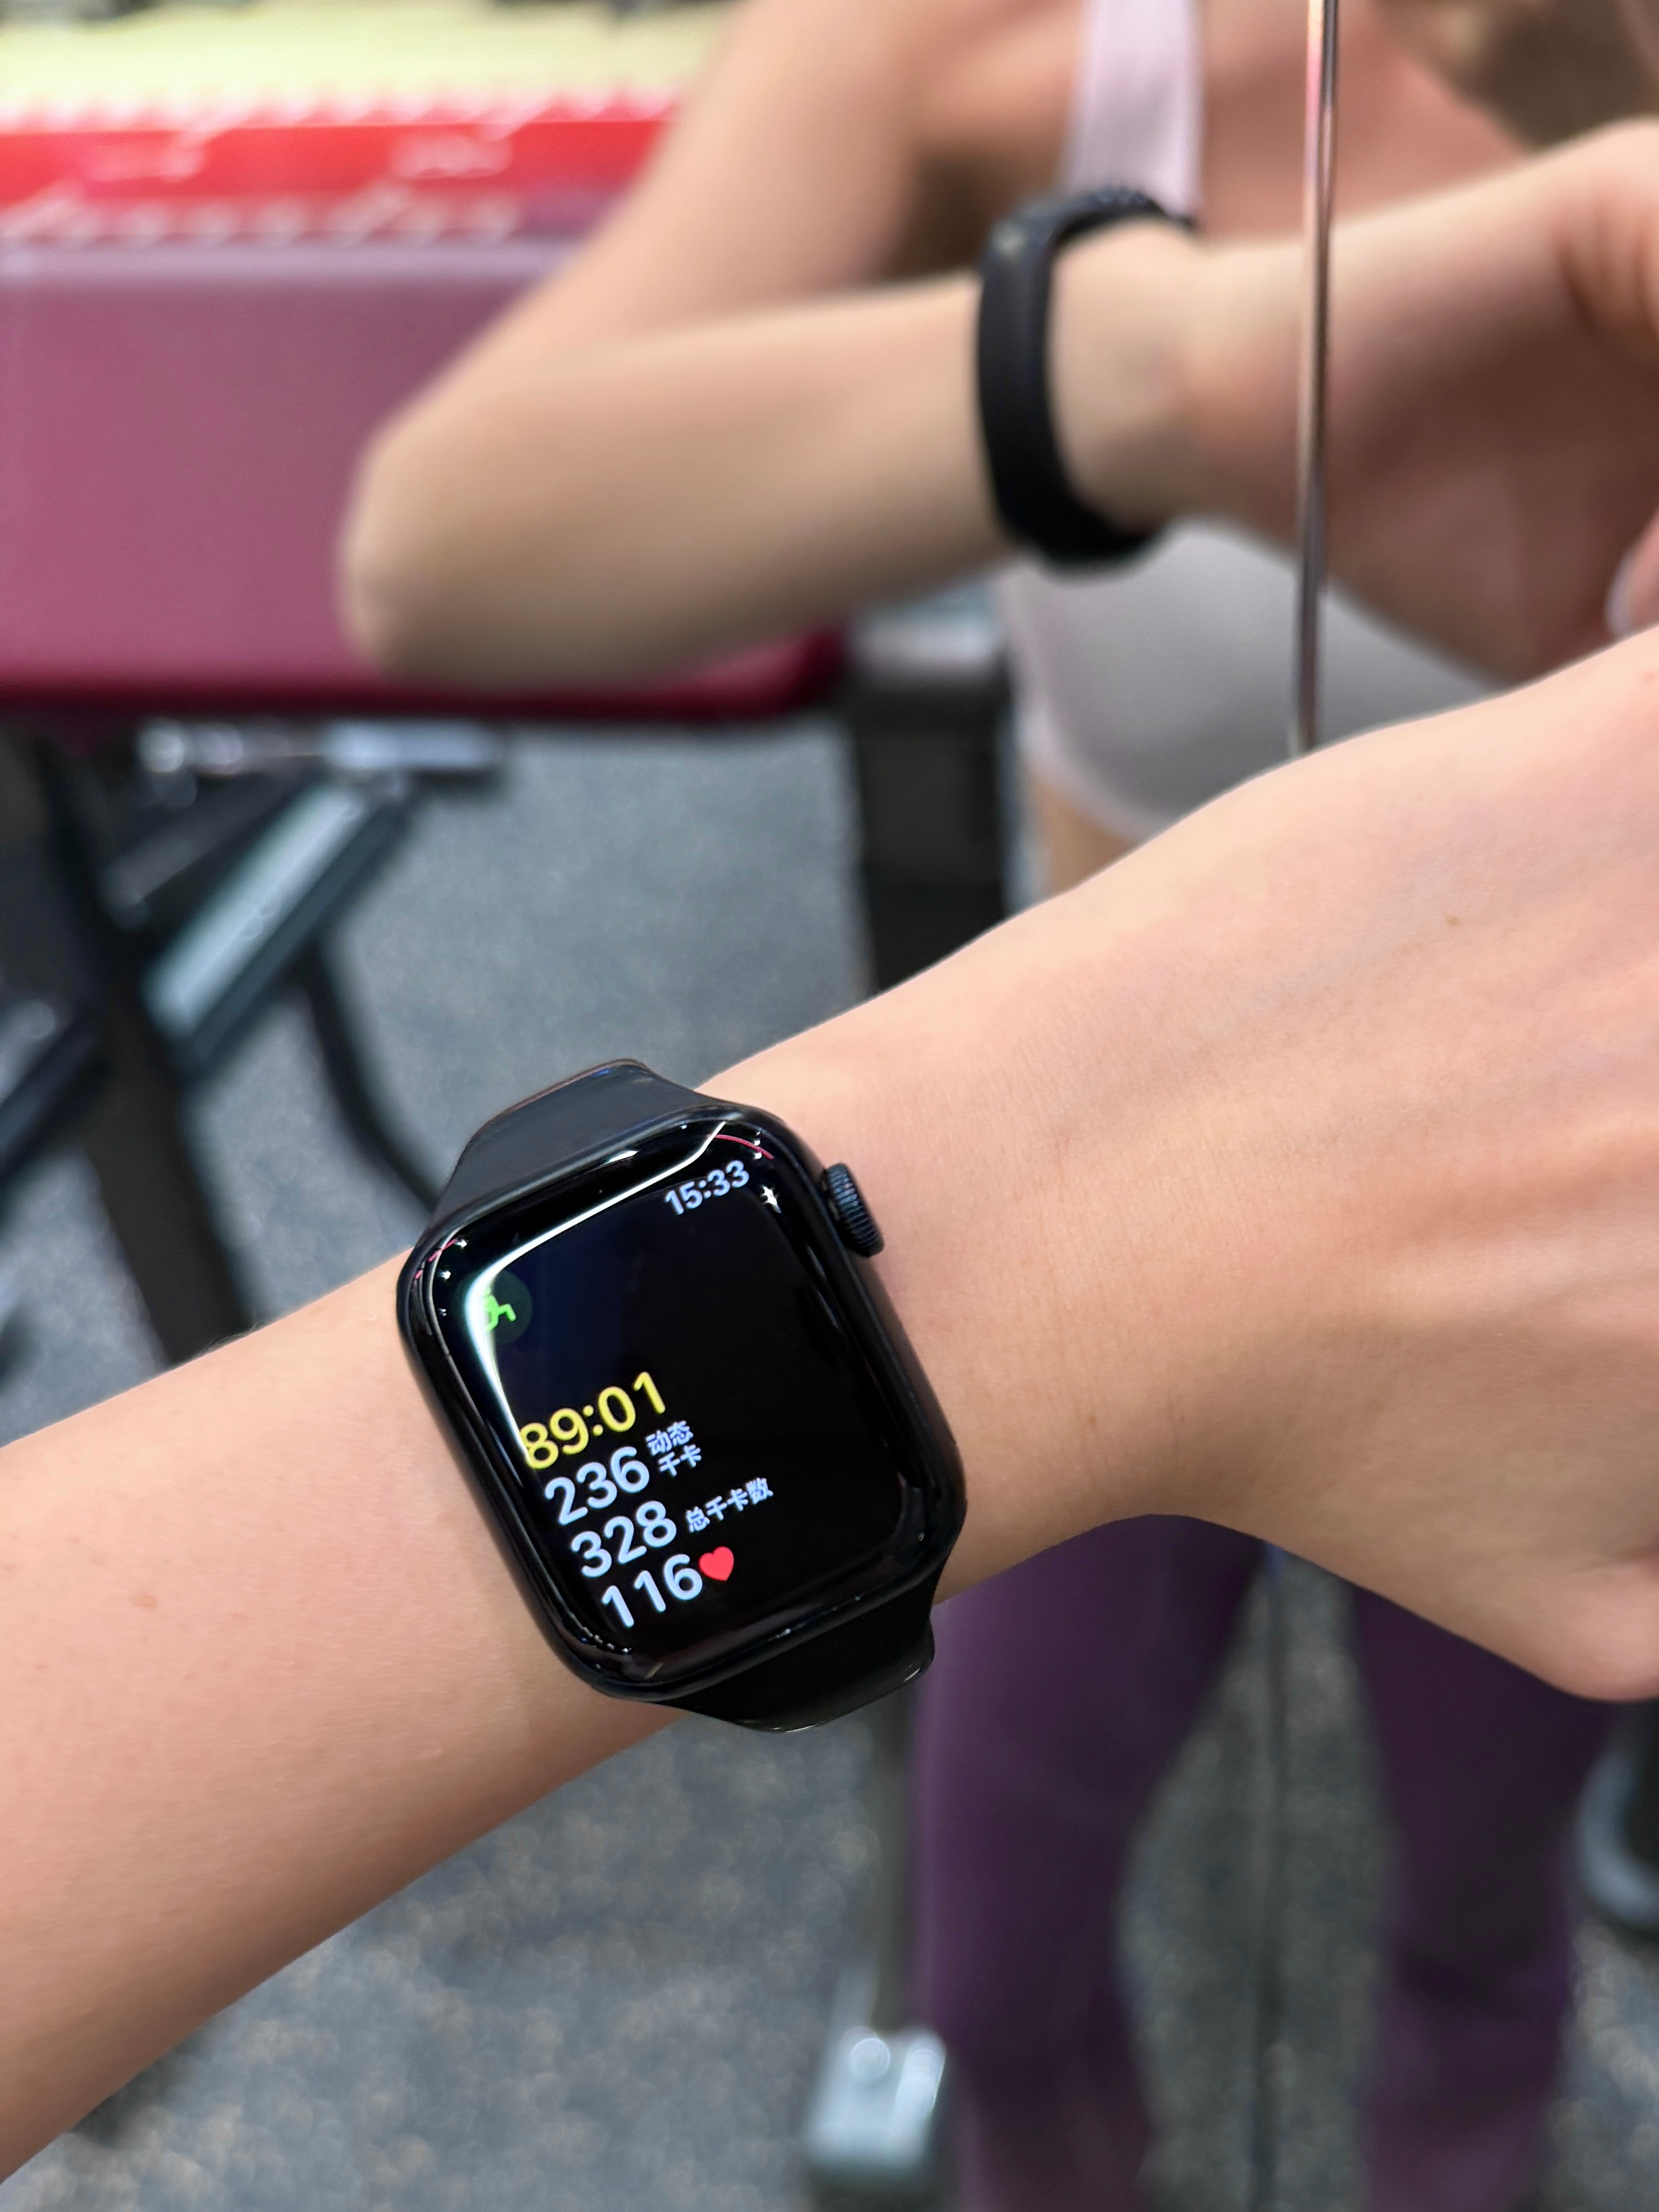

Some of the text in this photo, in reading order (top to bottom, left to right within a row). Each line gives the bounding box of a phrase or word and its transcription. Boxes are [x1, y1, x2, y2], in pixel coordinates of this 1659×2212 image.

[665, 1160, 749, 1215] 15:33
[520, 1372, 666, 1469] 89:01
[645, 1420, 694, 1456] 动态
[544, 1446, 649, 1525] 236
[658, 1444, 702, 1477] 千卡
[685, 1477, 774, 1533] 总千卡数
[571, 1500, 677, 1578] 328
[602, 1554, 702, 1627] 116
